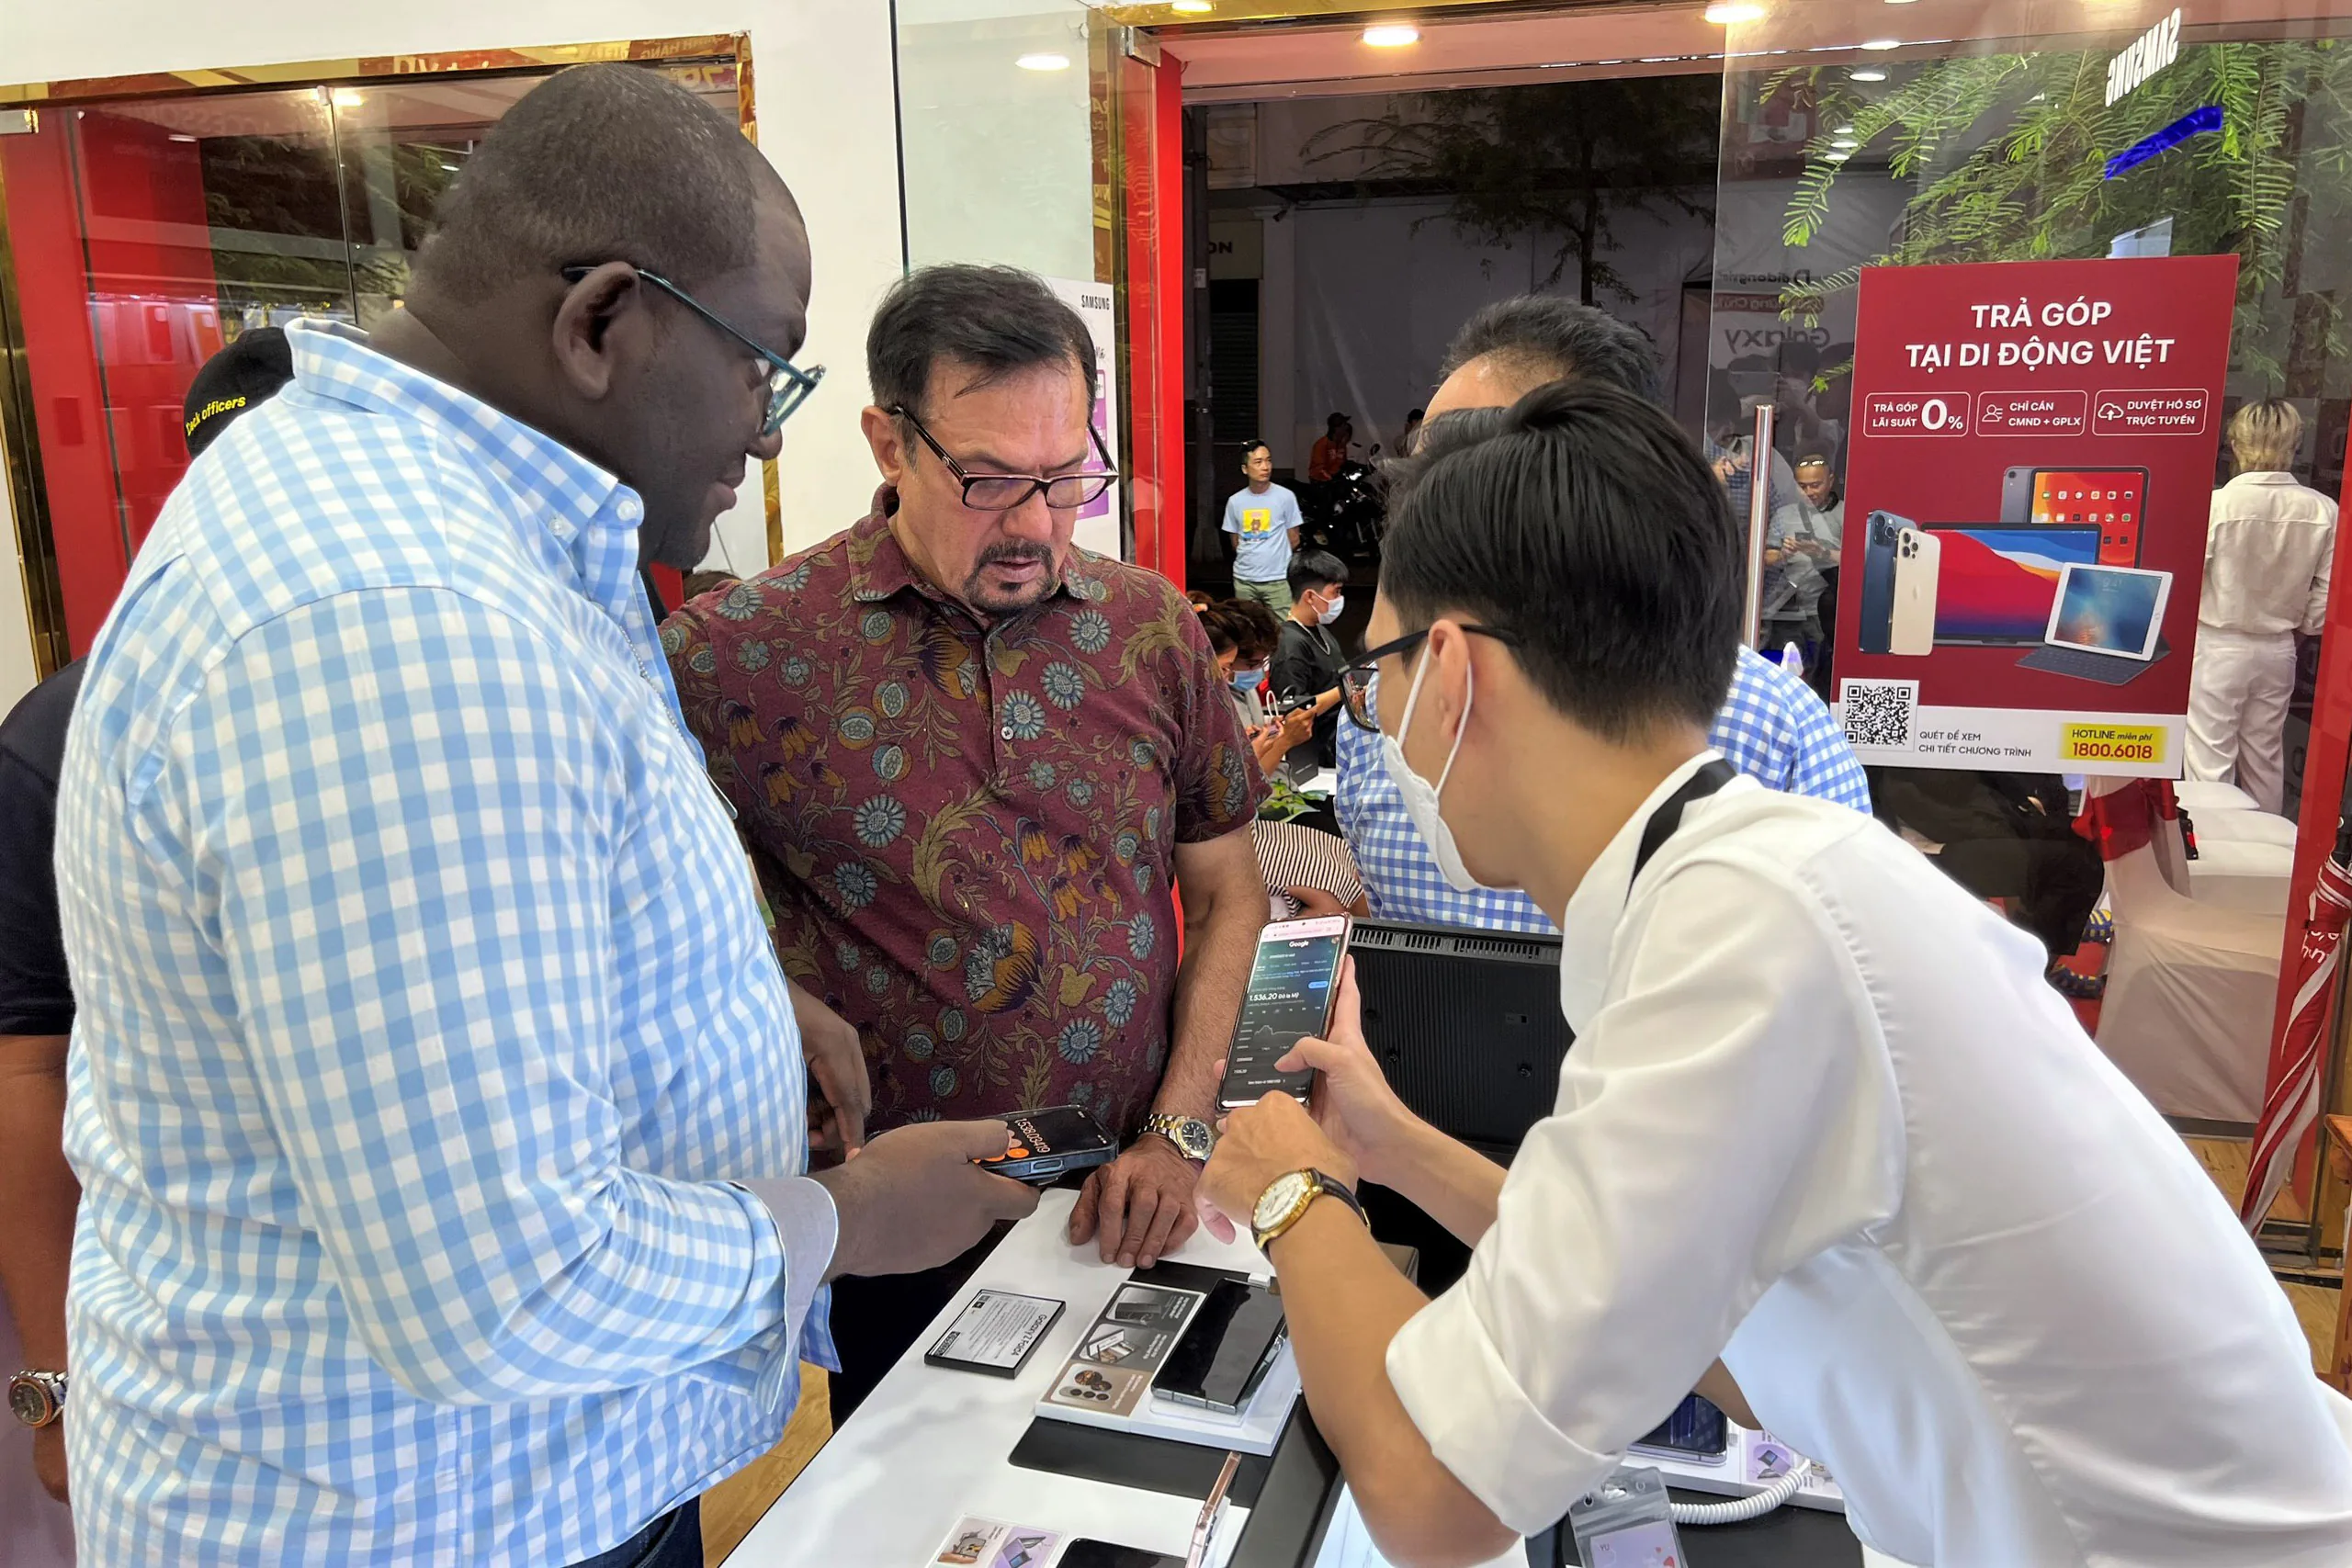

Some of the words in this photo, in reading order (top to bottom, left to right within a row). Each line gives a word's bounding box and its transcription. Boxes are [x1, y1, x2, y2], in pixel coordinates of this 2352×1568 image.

[1081, 294, 1110, 310] SAMSUNG
[1970, 297, 2033, 329] TRẢ
[2041, 296, 2112, 327] GÓP
[1905, 344, 1951, 373] TẠI
[1958, 343, 1990, 367] DI
[1996, 335, 2095, 372] ĐỘNG
[2101, 333, 2176, 370] VIỆT
[202, 397, 246, 420] officers
[1895, 400, 1919, 412] GÓP
[2008, 417, 2041, 426] CMND
[2052, 417, 2082, 426] GPLX
[1919, 730, 1945, 740] QUÉT
[1962, 732, 1982, 741] XEM
[2072, 728, 2116, 739] HOTLINE
[1918, 744, 1935, 753] CHI
[2073, 741, 2153, 759] 1800.6018
[1288, 940, 1310, 948] Google
[1024, 1314, 1047, 1335] Galaxy
